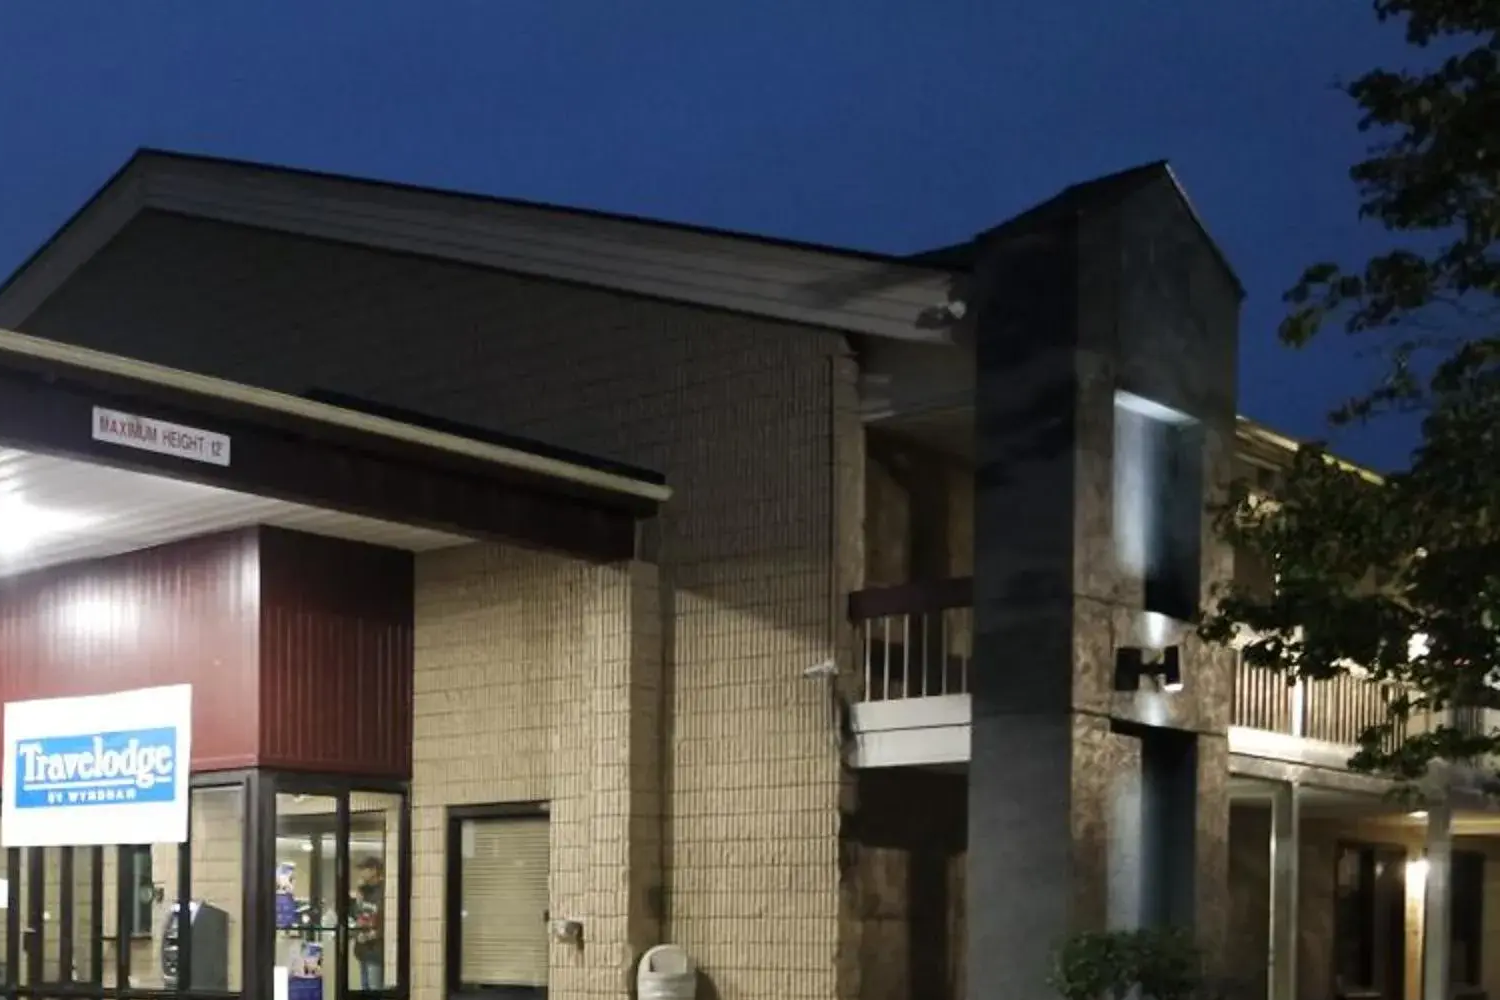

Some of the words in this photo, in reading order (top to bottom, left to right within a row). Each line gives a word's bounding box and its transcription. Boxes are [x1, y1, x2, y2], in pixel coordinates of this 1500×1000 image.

[99, 415, 157, 442] MAXIMUM
[162, 430, 205, 453] HEIGHT
[19, 736, 173, 789] Travelodge
[67, 787, 137, 803] WYNDHAM
